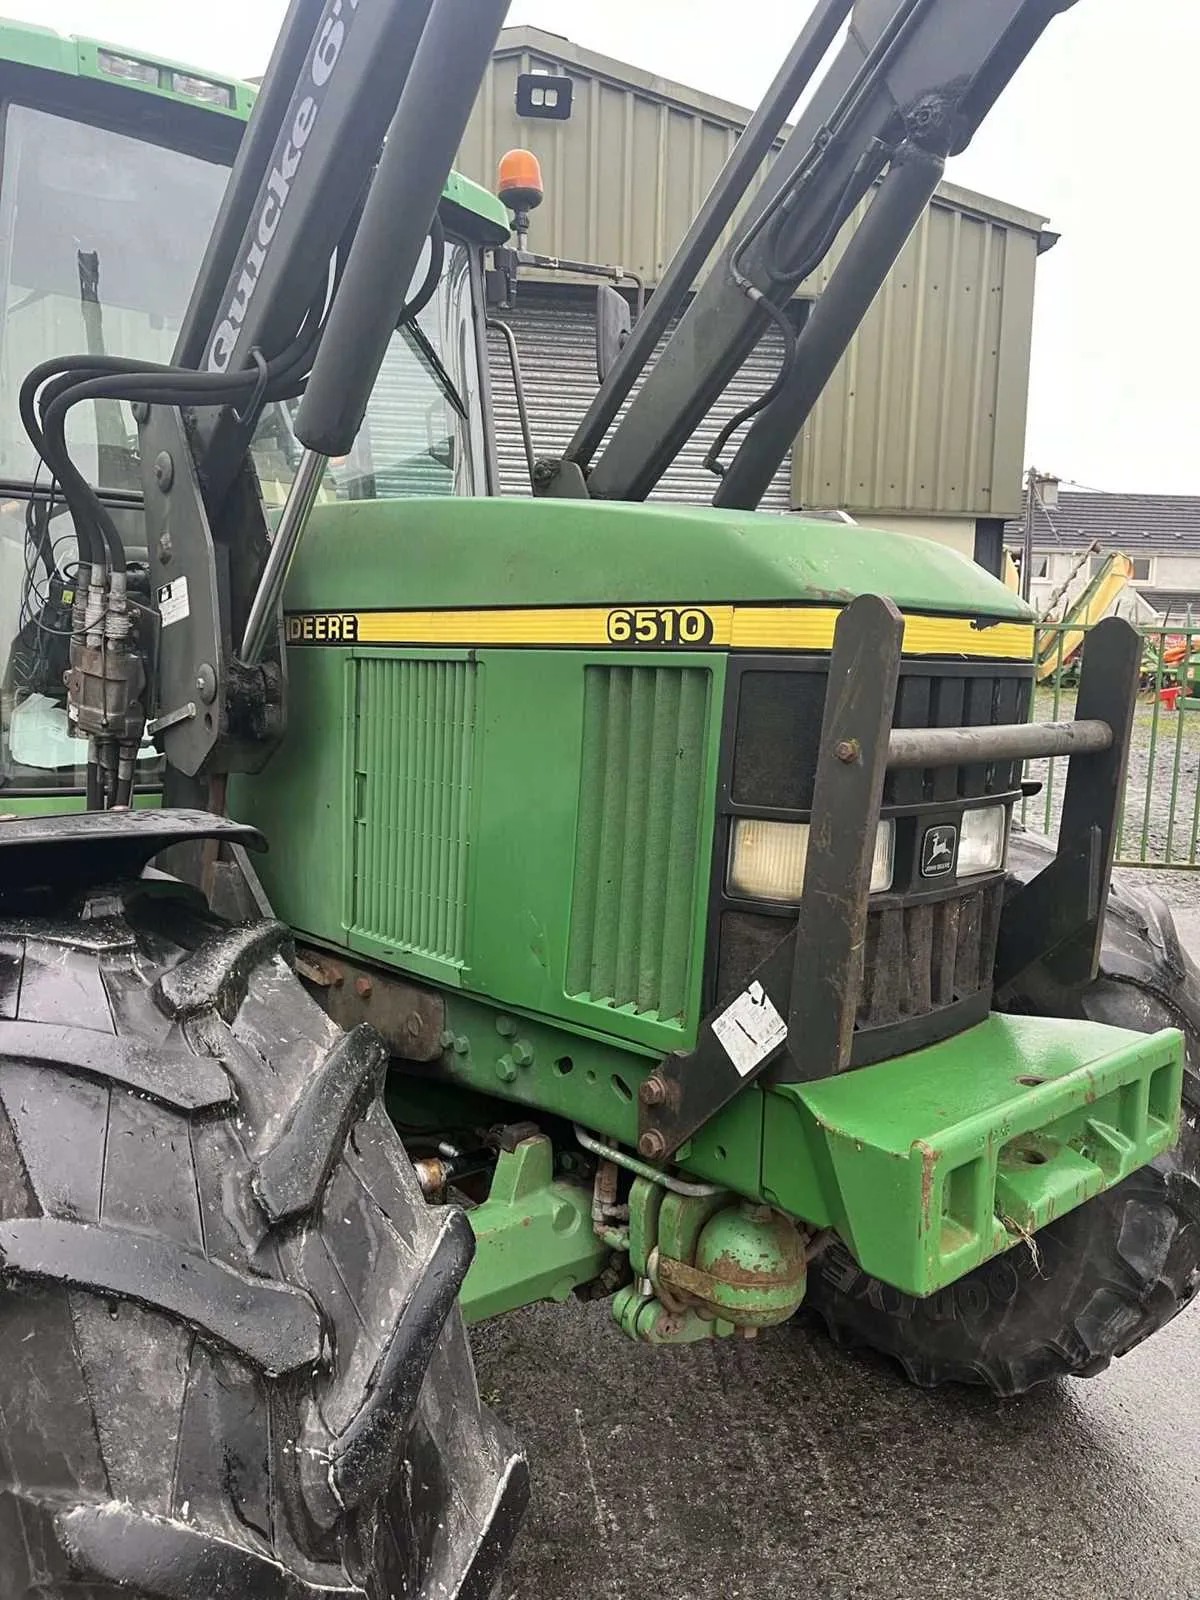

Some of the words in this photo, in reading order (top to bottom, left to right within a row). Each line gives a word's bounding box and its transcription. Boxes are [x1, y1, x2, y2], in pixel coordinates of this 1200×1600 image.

[207, 96, 318, 373] Quicke
[290, 615, 355, 640] DEERE
[607, 608, 708, 642] 6510
